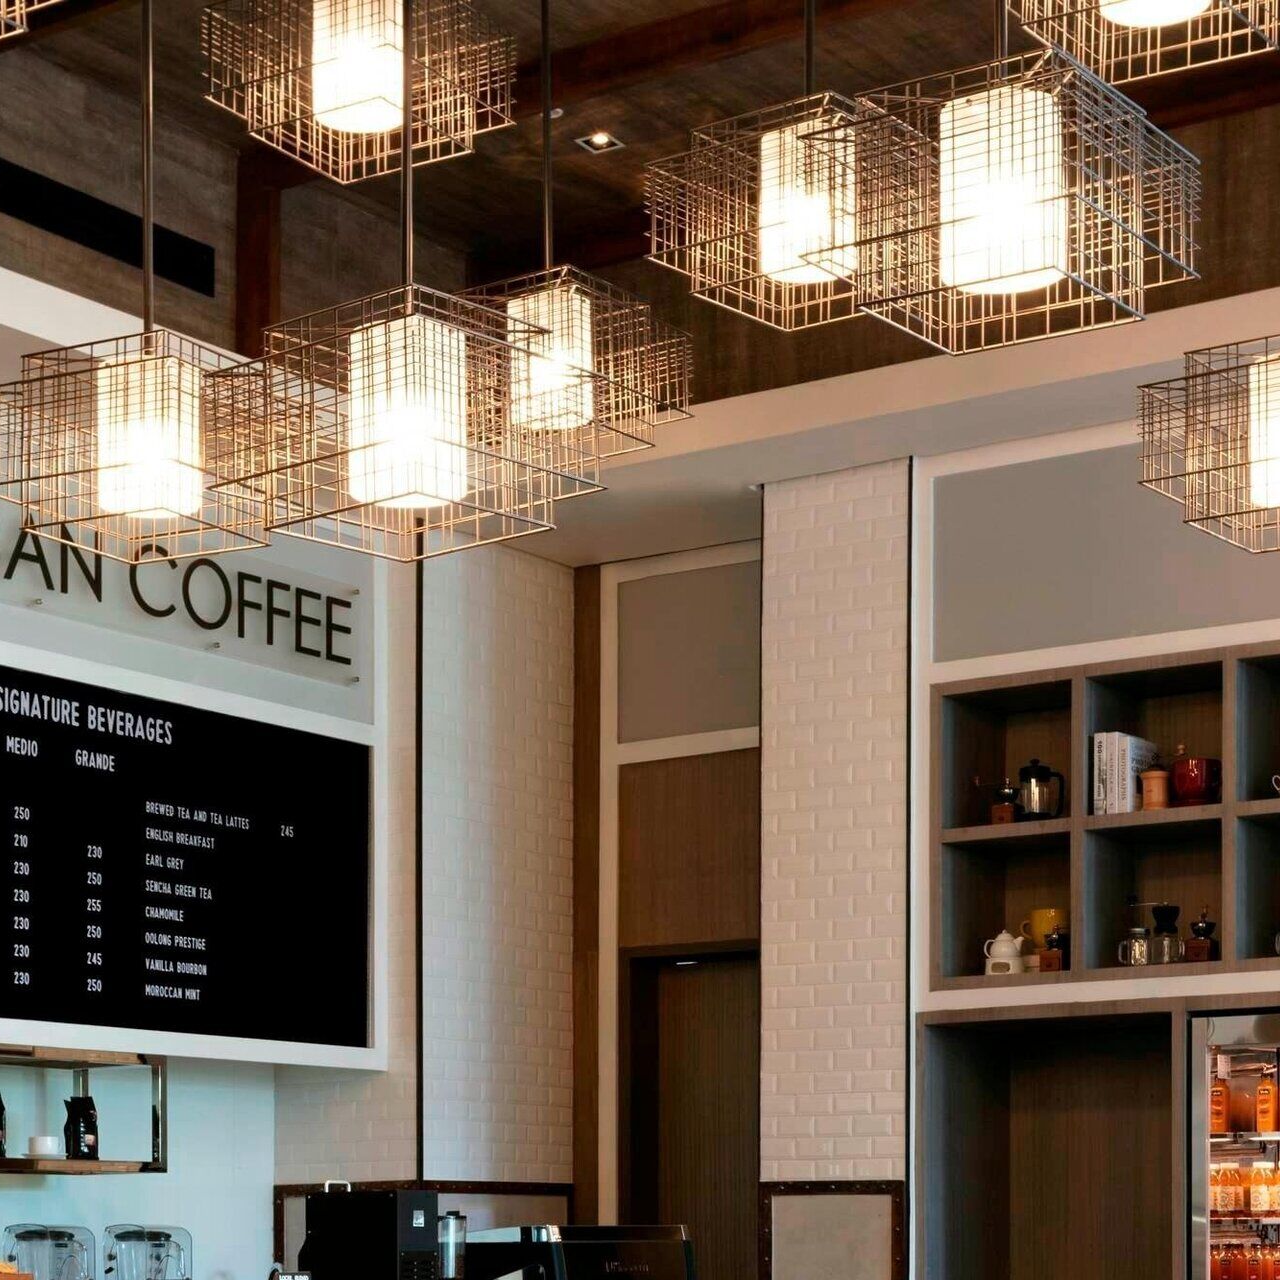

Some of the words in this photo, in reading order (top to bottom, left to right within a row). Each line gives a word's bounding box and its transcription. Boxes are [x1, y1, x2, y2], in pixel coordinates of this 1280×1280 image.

[128, 542, 354, 666] COFFEE
[87, 704, 173, 745] BEVERAGES
[6, 735, 38, 758] MEDIO
[75, 748, 115, 772] GRANDE
[13, 805, 30, 821] 250
[145, 800, 175, 817] BREWED
[176, 806, 191, 820] TEA
[193, 809, 208, 823] AND
[209, 812, 223, 826] TEA
[225, 815, 250, 830] LATTES
[13, 833, 29, 848] 210
[145, 827, 175, 843] ENGLISH
[175, 832, 215, 850] BREAKFAST
[87, 844, 103, 859] 230
[13, 860, 30, 876] 230
[145, 853, 164, 868] EARL
[166, 856, 185, 870] GREY
[87, 871, 103, 886] 250
[13, 888, 30, 903] 230
[145, 879, 172, 895] SENCHA
[174, 883, 197, 898] GREEN
[199, 886, 213, 900] TEA
[86, 898, 102, 913] 255
[145, 905, 184, 922] CHAMOMILE
[13, 916, 30, 930] 230
[86, 924, 102, 939] 250
[144, 931, 172, 947] OOLONG
[174, 935, 206, 951] PRESTIGE
[13, 943, 30, 958] 230
[86, 951, 103, 966] 245
[145, 957, 175, 973] VANILLA
[176, 961, 208, 976] BOURBON
[13, 971, 30, 986] 230
[86, 978, 103, 993] 250
[145, 983, 183, 999] MOROCCAN
[185, 988, 201, 1001] MINT
